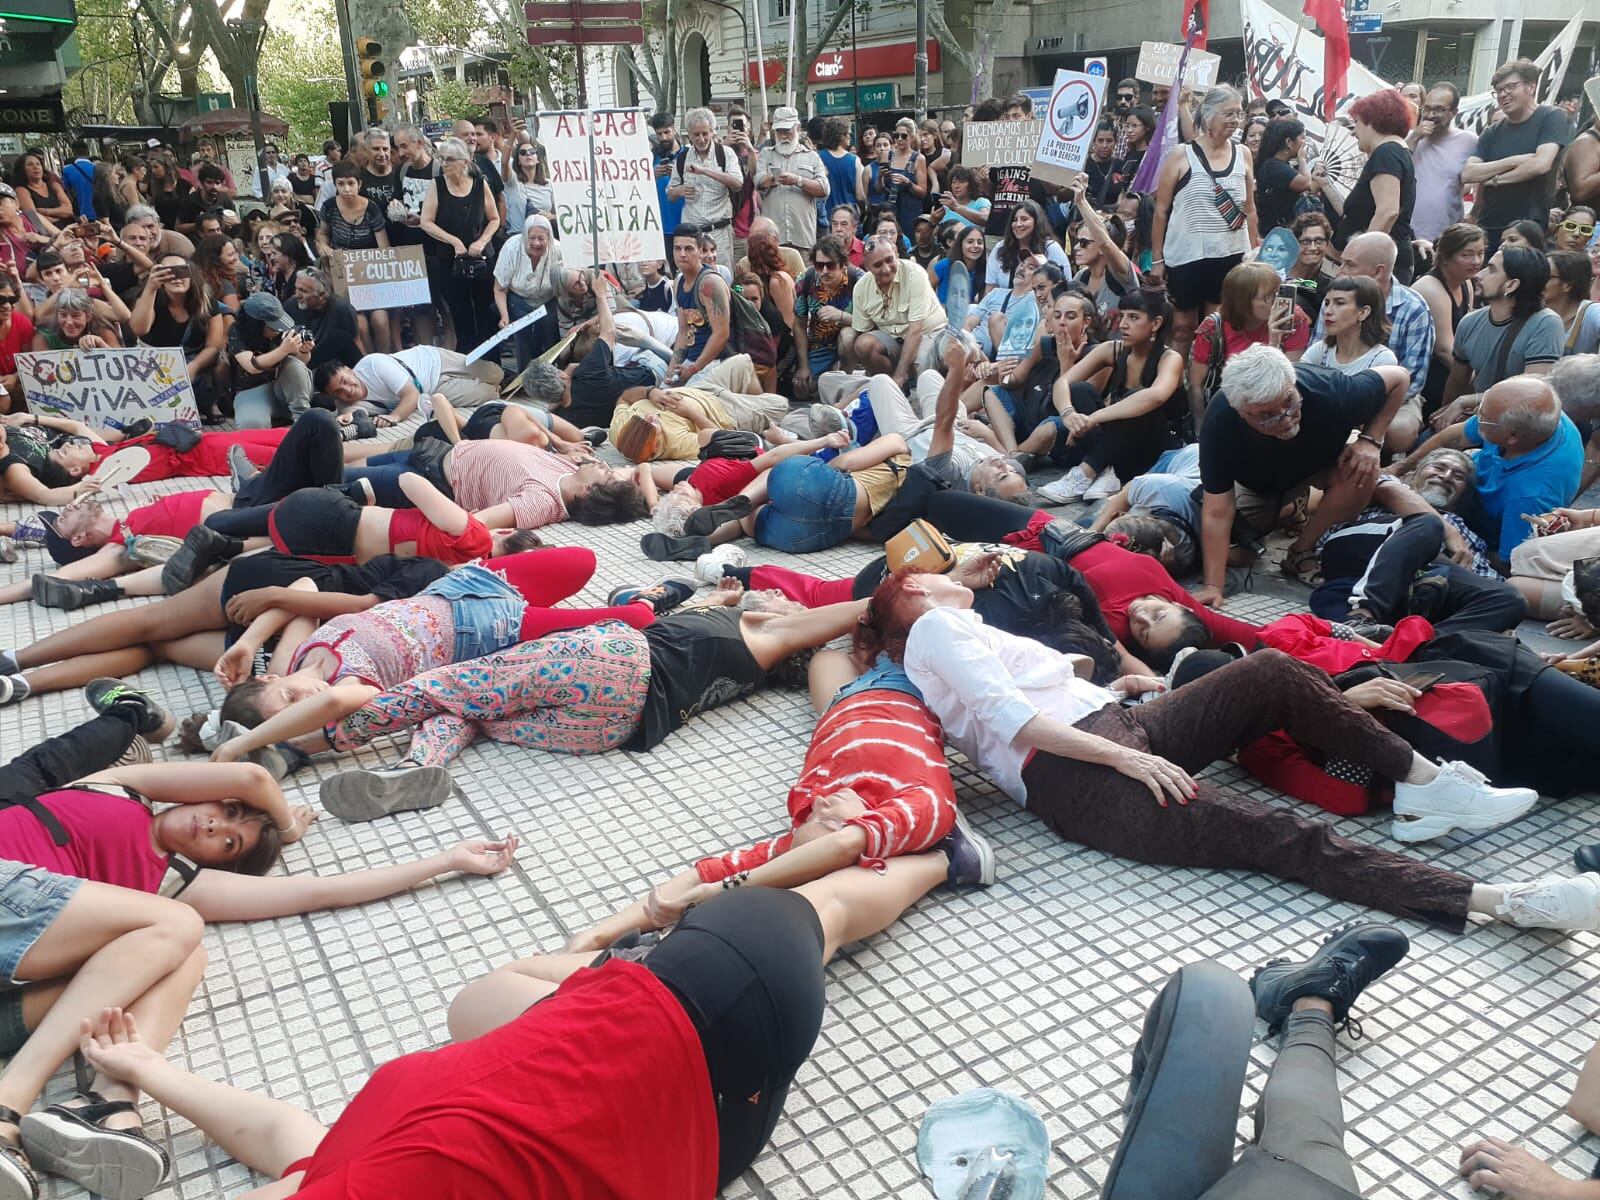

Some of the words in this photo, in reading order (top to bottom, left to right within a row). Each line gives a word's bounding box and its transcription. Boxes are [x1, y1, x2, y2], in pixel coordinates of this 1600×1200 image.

[1153, 43, 1169, 52] NO
[816, 61, 838, 76] Claro
[872, 92, 886, 100] 147
[1031, 102, 1048, 111] bra
[0, 109, 51, 122] ONE
[967, 121, 1021, 138] ENCENDAMOS
[1025, 121, 1035, 134] LA
[967, 137, 990, 151] PARA
[995, 136, 1013, 149] QUE
[1016, 135, 1029, 148] NO
[1047, 139, 1054, 148] LA
[1055, 141, 1080, 153] PROTESTA
[986, 150, 1001, 165] LA
[1004, 149, 1036, 164] CULTU
[1042, 147, 1049, 155] ES
[1050, 148, 1057, 157] UN
[1058, 150, 1081, 163] DERECHO
[366, 260, 423, 280] CULTURA
[33, 354, 165, 385] CULTURA
